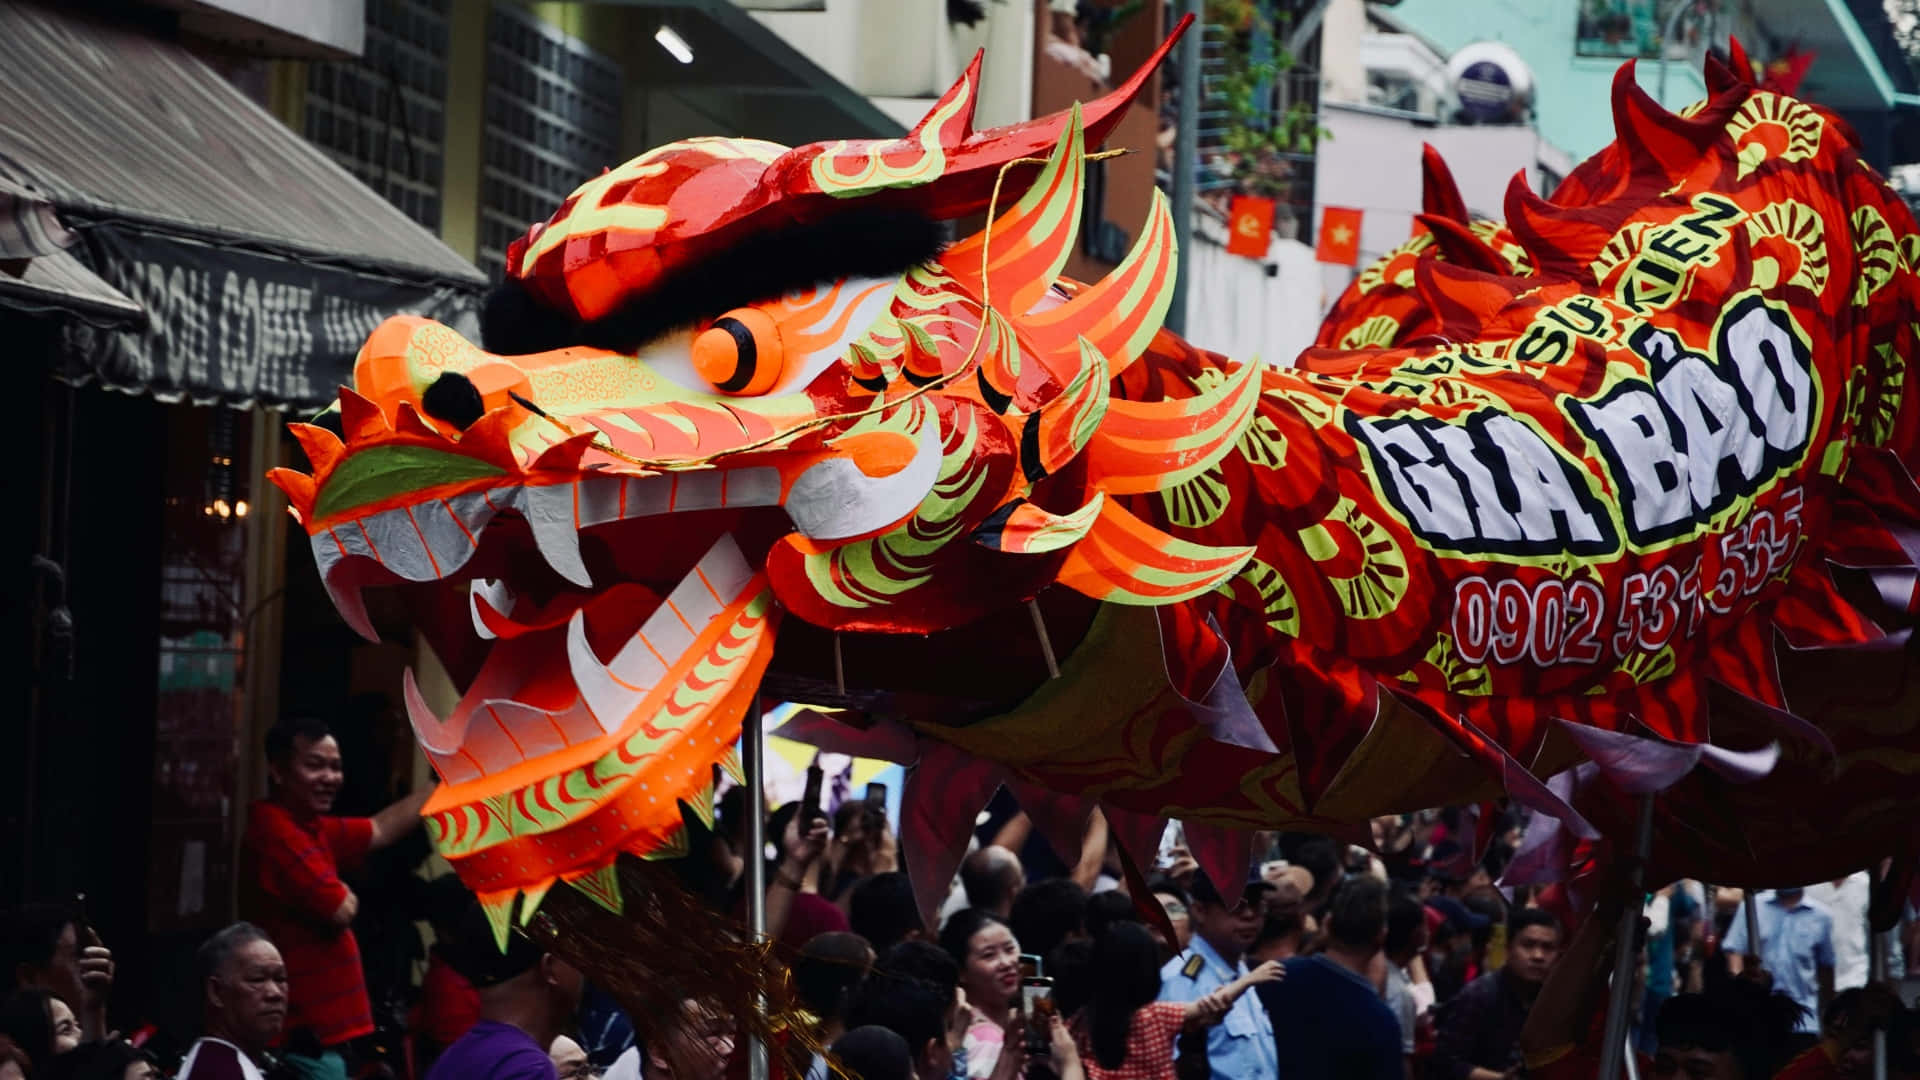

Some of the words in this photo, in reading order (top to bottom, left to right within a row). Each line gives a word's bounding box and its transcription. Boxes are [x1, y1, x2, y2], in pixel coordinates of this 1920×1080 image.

[1350, 410, 1612, 549] GIA
[1575, 302, 1815, 538] BẢO
[1453, 575, 1605, 668] 0902
